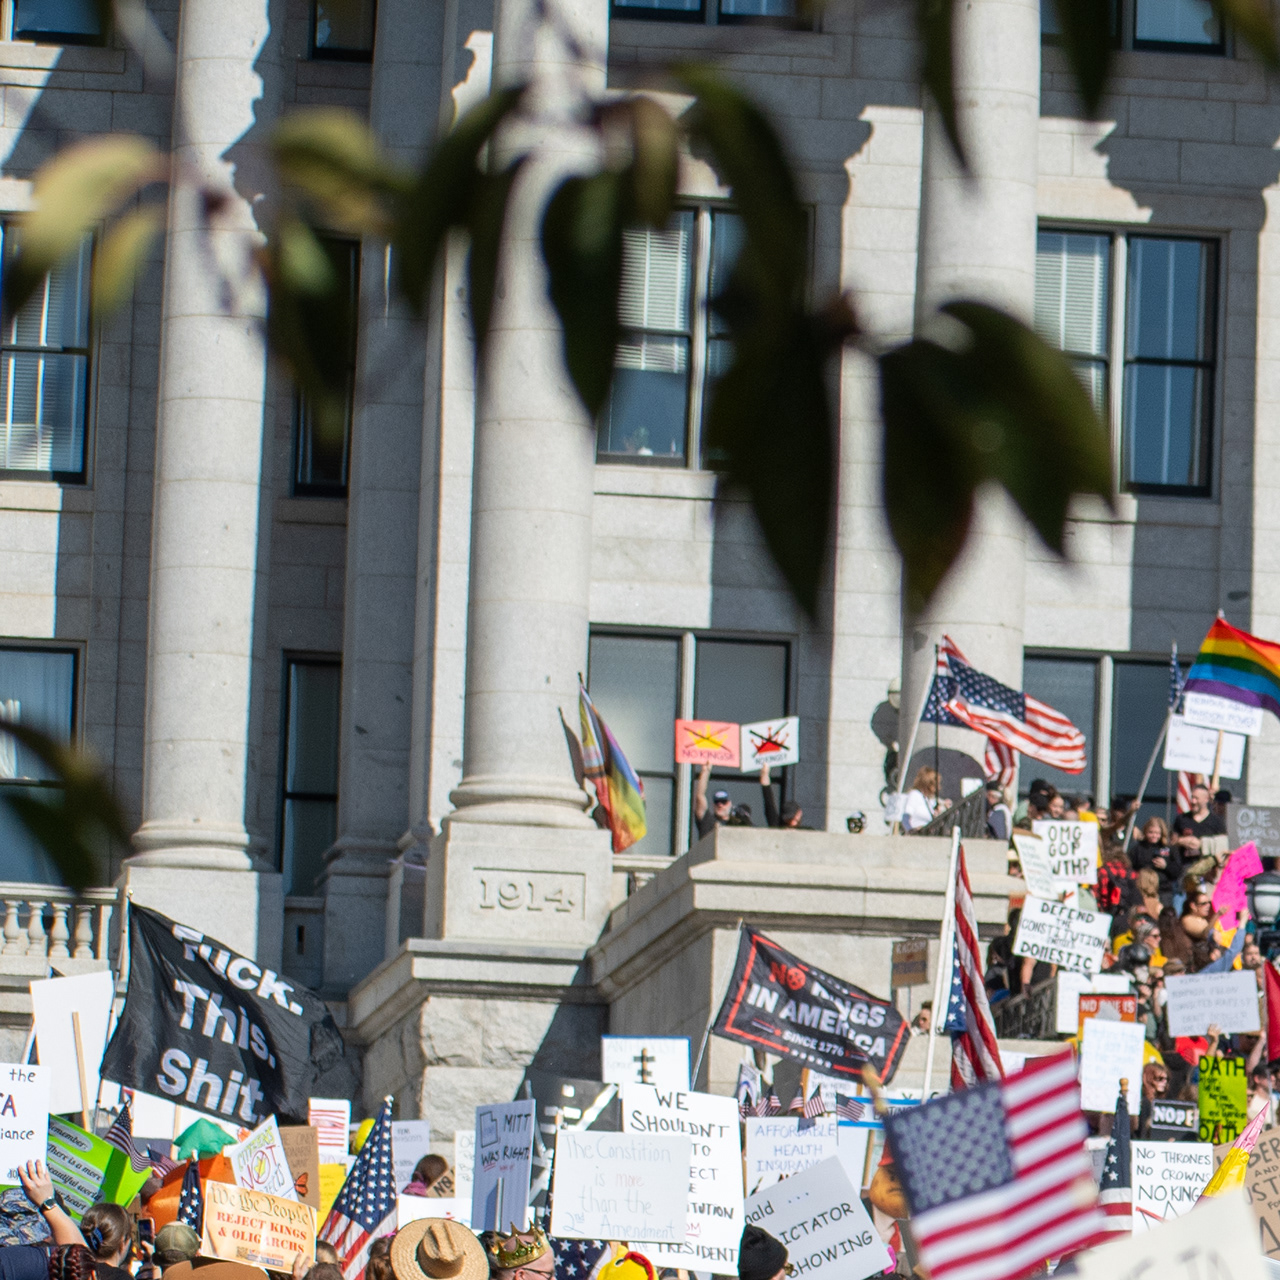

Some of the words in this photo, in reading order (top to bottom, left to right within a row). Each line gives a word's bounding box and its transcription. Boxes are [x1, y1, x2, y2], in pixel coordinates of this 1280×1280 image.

[1236, 807, 1272, 827] ONE
[1048, 825, 1082, 842] OMG
[479, 879, 576, 912] 1914
[1040, 902, 1095, 924] DEFEND
[1021, 918, 1106, 948] CONSTITUTION
[1020, 941, 1093, 971] DOMESTIC
[770, 961, 806, 991] NO
[746, 983, 780, 1014] IN
[781, 1029, 818, 1050] SINCE
[9, 1068, 36, 1083] the
[1200, 1056, 1247, 1078] OATH
[655, 1088, 690, 1112] WE
[504, 1113, 532, 1134] MITT
[630, 1111, 731, 1139] SHOULDN'T
[1153, 1104, 1196, 1125] NOPE
[564, 1133, 593, 1161] The
[691, 1142, 712, 1158] TO
[774, 1143, 823, 1157] HEALTH
[1136, 1147, 1156, 1160] NO
[1160, 1151, 1213, 1166] THRONES
[481, 1152, 500, 1167] WAS
[1254, 1164, 1279, 1177] AND
[594, 1165, 607, 1188] is
[615, 1172, 645, 1189] more
[1136, 1164, 1154, 1177] NO
[1161, 1168, 1212, 1183] CROWNS
[581, 1188, 618, 1216] than
[623, 1190, 653, 1216] the
[1138, 1184, 1168, 1203] NO
[210, 1185, 237, 1207] We
[258, 1195, 308, 1225] People
[216, 1211, 267, 1230] REJECT
[270, 1221, 308, 1241] KINGS
[217, 1226, 228, 1238] &
[600, 1214, 676, 1240] Amendment
